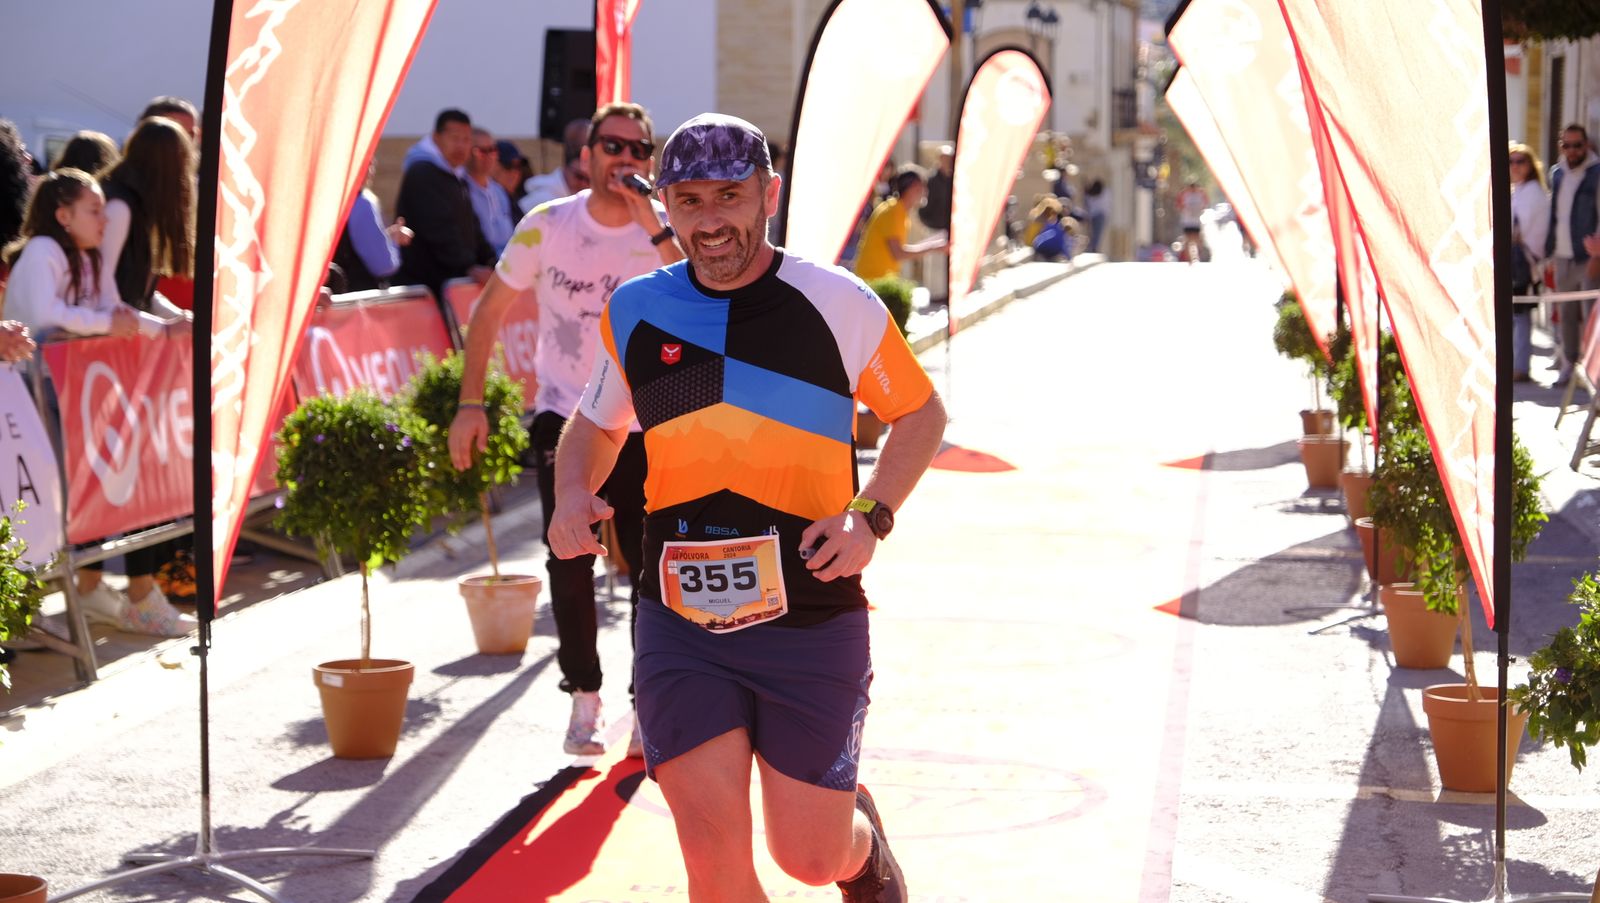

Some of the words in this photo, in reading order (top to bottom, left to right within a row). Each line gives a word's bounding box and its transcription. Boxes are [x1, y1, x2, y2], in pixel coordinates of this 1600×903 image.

[547, 266, 595, 300] Pepe
[600, 274, 621, 303] Y
[722, 544, 752, 554] CANTORIA
[680, 560, 757, 593] 355
